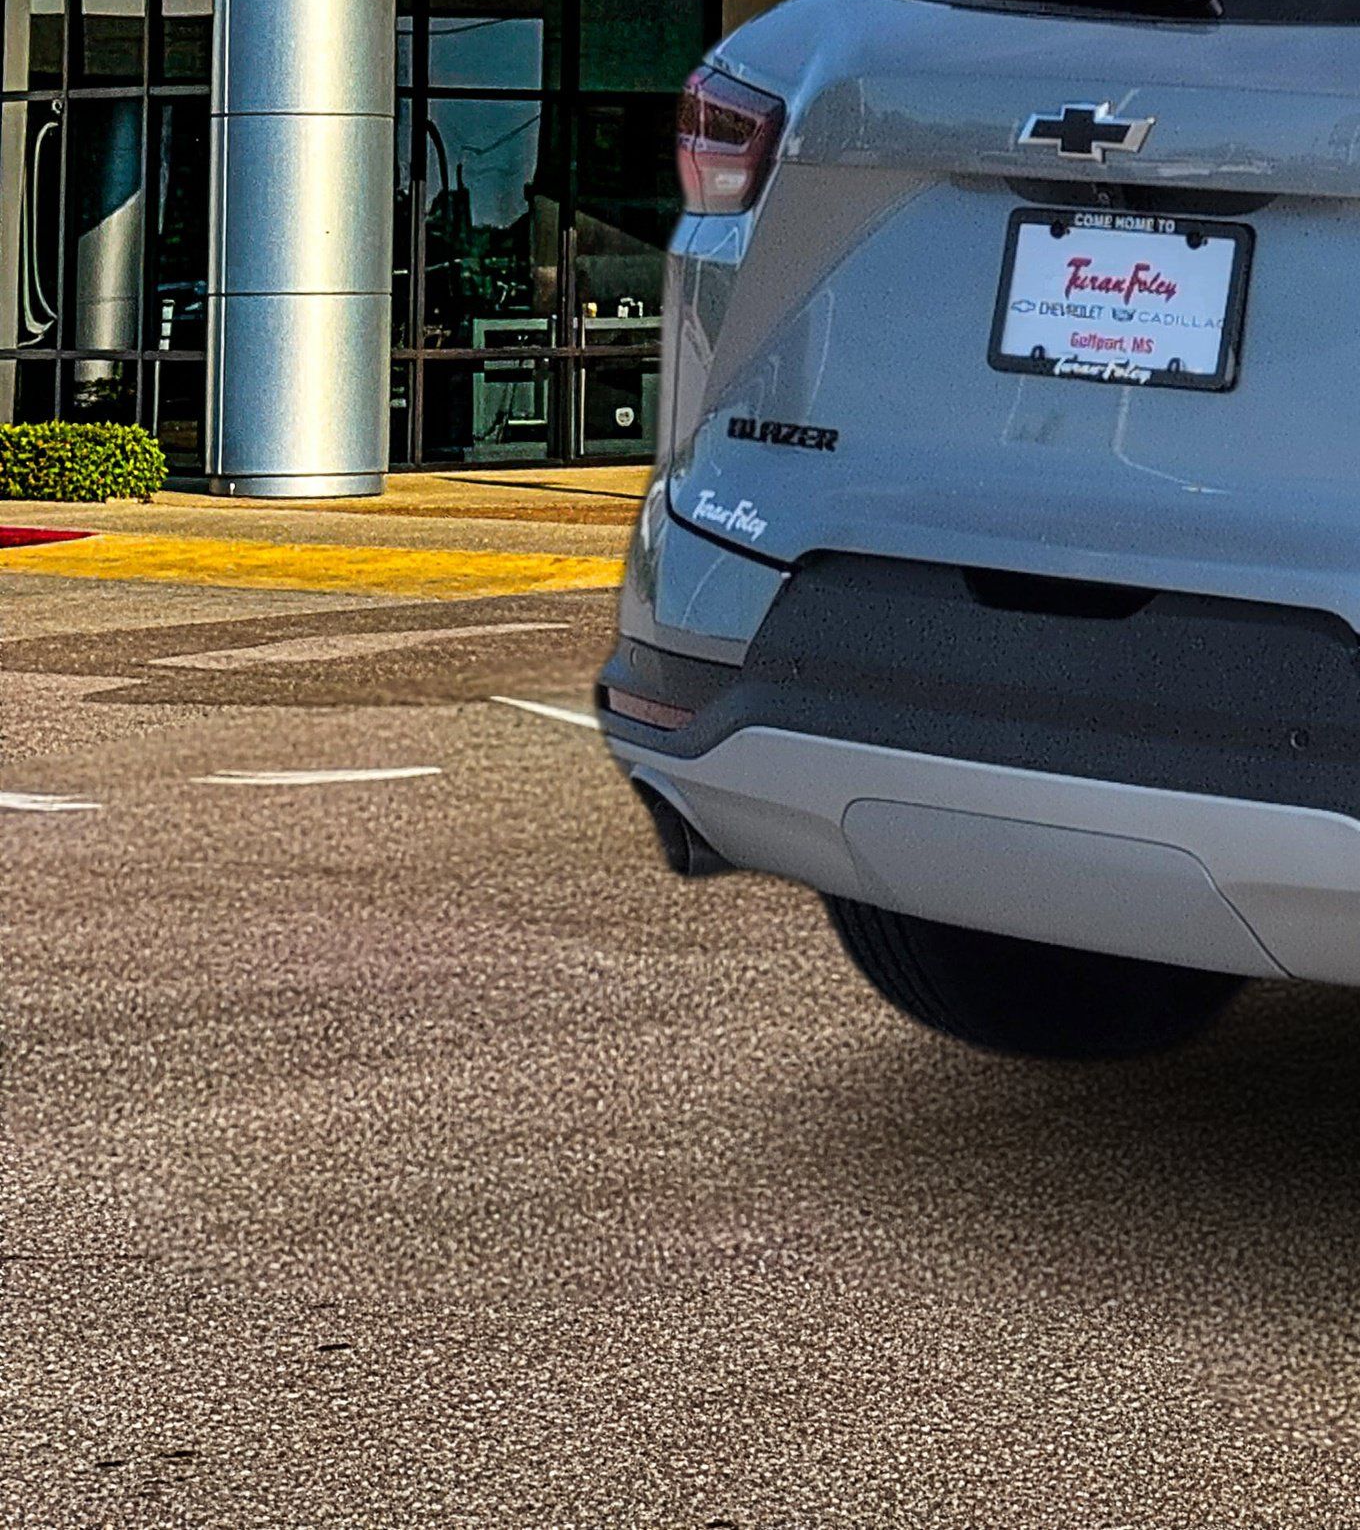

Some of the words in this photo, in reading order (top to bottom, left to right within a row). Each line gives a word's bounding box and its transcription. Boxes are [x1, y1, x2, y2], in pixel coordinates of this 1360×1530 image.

[1073, 212, 1113, 229] COME
[1115, 215, 1155, 232] HOME
[1157, 217, 1176, 234] TO
[1064, 257, 1126, 300] Turan
[1123, 262, 1177, 306] Foley
[1131, 336, 1155, 355] MS
[727, 417, 839, 452] BLAZER
